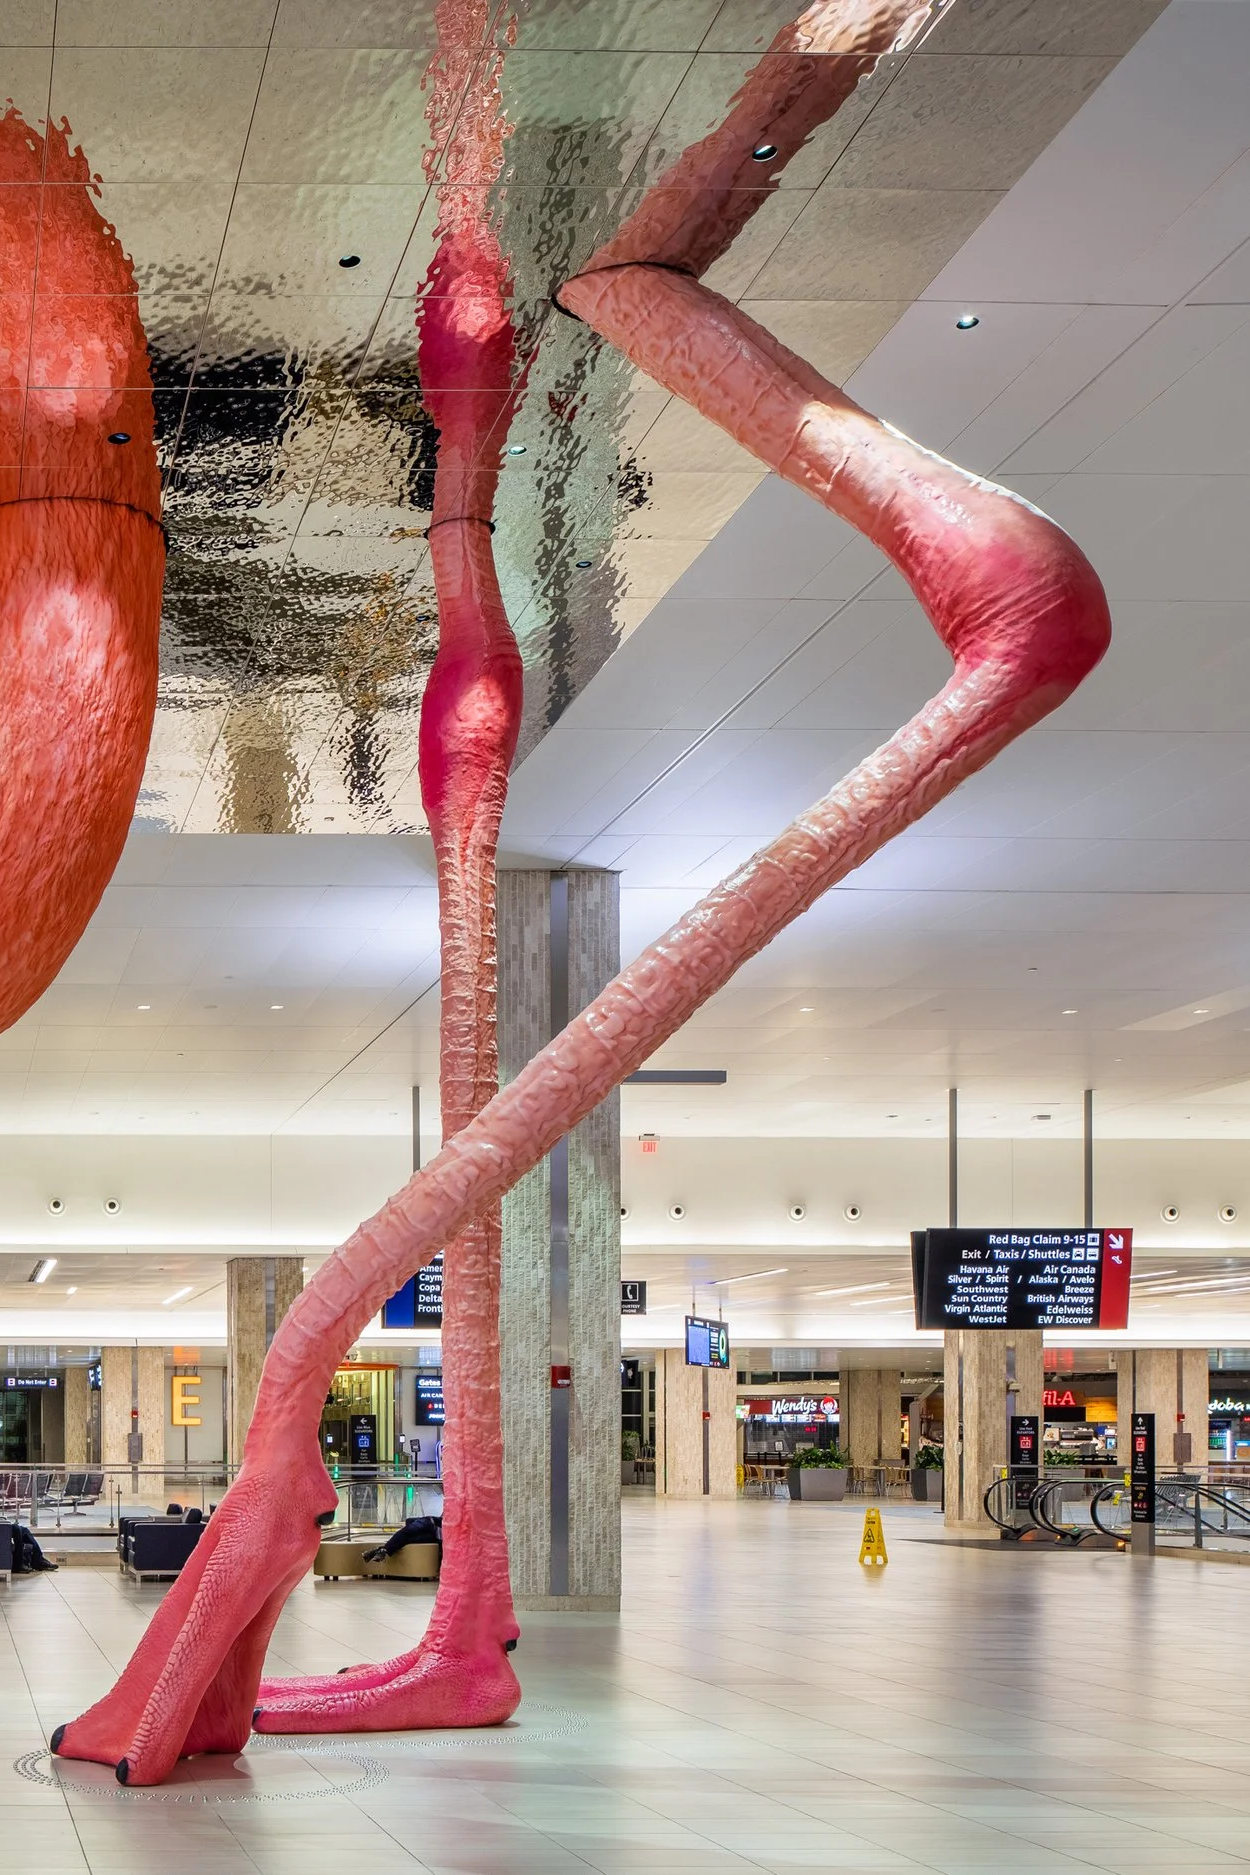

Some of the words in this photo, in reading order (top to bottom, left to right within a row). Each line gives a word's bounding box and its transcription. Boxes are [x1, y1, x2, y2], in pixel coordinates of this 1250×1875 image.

[643, 1141, 657, 1152] EXIT
[989, 1234, 1009, 1244] Red
[1011, 1234, 1030, 1247] Bag
[1032, 1234, 1061, 1244] Claim
[1063, 1235, 1086, 1244] 9-15
[961, 1249, 982, 1259] Exit
[993, 1249, 1019, 1259] Taxis
[1028, 1248, 1071, 1259] Shuttles
[959, 1265, 993, 1274] Havana
[995, 1265, 1010, 1274] Air
[1043, 1264, 1059, 1274] Air
[1060, 1265, 1096, 1274] Canada
[419, 1273, 442, 1283] Caym
[948, 1274, 972, 1283] Silver
[985, 1274, 1009, 1284] Spirit
[1029, 1274, 1058, 1283] Alaska
[1069, 1275, 1095, 1283] Avelo
[419, 1283, 440, 1293] Copa
[957, 1285, 1009, 1293] Southwest
[1064, 1285, 1095, 1293] Breeze
[418, 1294, 443, 1303] Delta
[951, 1294, 969, 1302] Sun
[970, 1294, 1008, 1304] Country
[1027, 1294, 1055, 1303] British
[1057, 1294, 1094, 1304] Airways
[417, 1304, 443, 1313] Fronti
[944, 1304, 970, 1315] Virgin
[972, 1304, 1008, 1313] Atlantic
[1046, 1305, 1094, 1314] Edelweiss
[968, 1315, 1007, 1323] WestJet
[1038, 1315, 1054, 1324] EW
[1055, 1315, 1093, 1324] Discover
[171, 1376, 202, 1426] E
[1043, 1390, 1076, 1406] fil-A
[772, 1396, 817, 1415] Wendy's
[1207, 1398, 1244, 1414] doba
